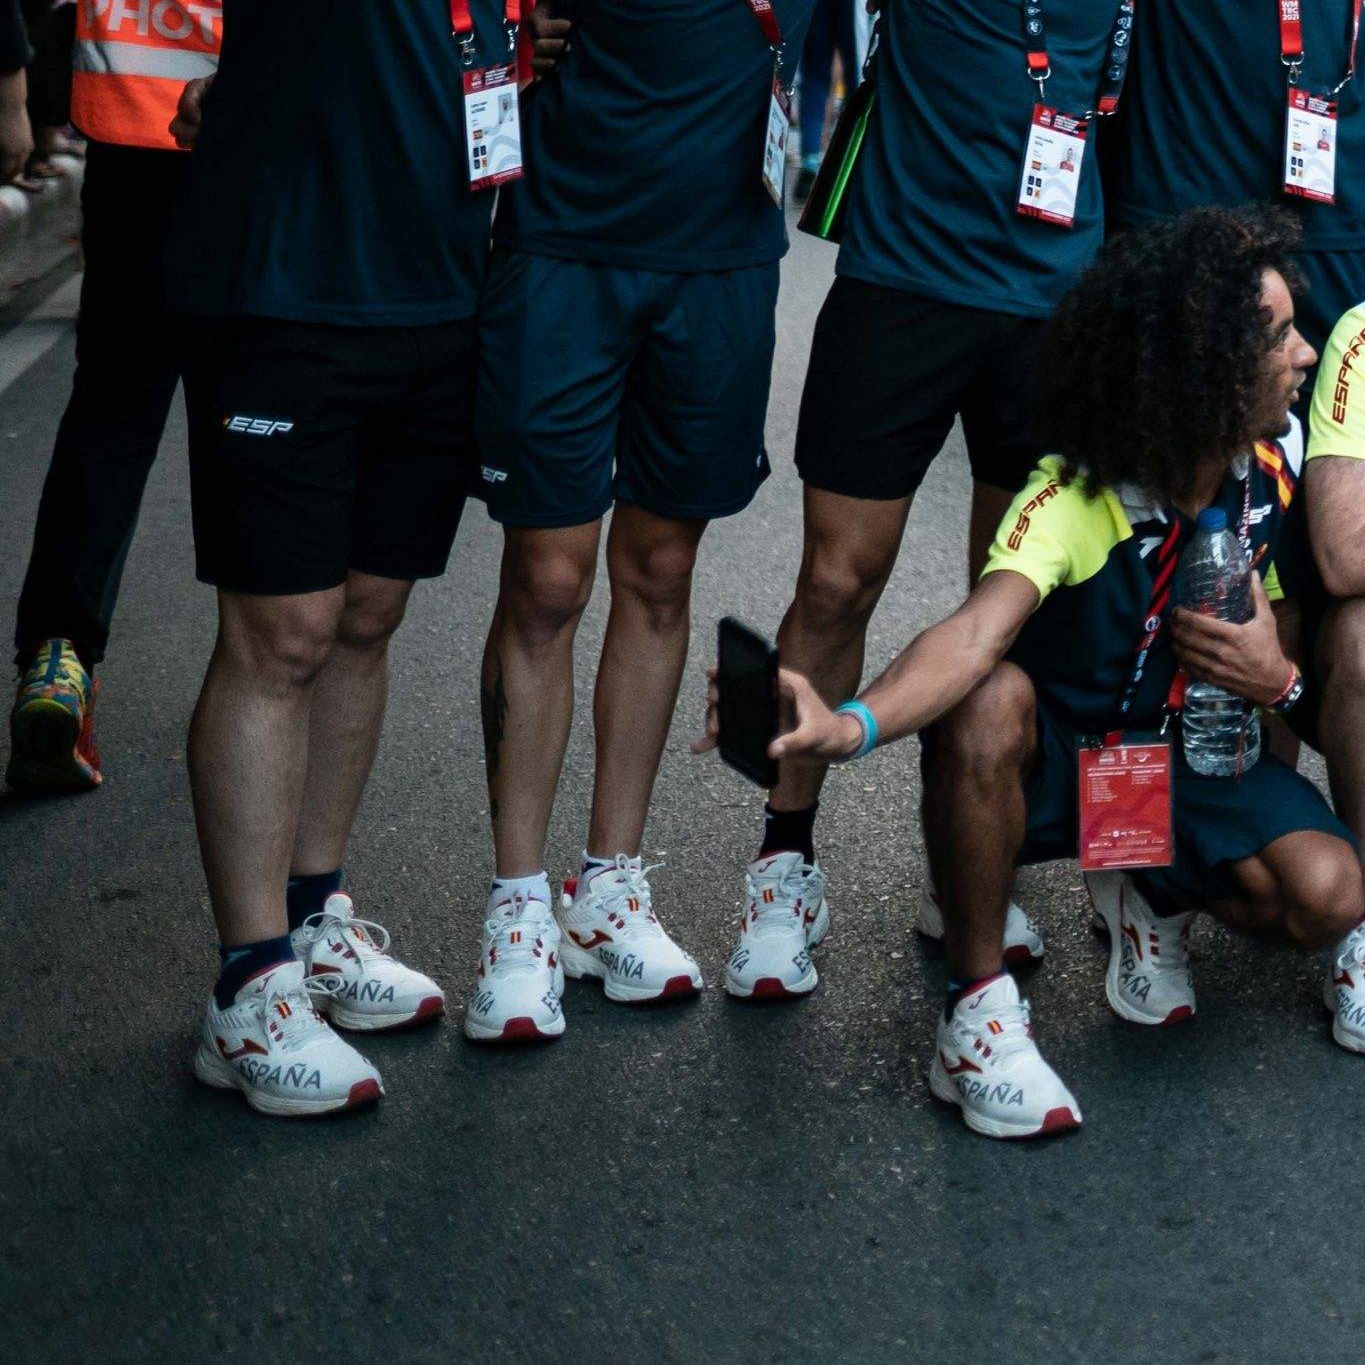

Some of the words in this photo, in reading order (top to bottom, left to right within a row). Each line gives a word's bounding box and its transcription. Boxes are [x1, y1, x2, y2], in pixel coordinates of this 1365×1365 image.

[227, 415, 294, 437] ESP
[482, 465, 508, 483] SP
[1007, 478, 1061, 552] ESPAÑ
[599, 947, 644, 980] ESPAÑA
[238, 1058, 321, 1089] ESPAÑA
[956, 1075, 1024, 1106] ESPAÑA
